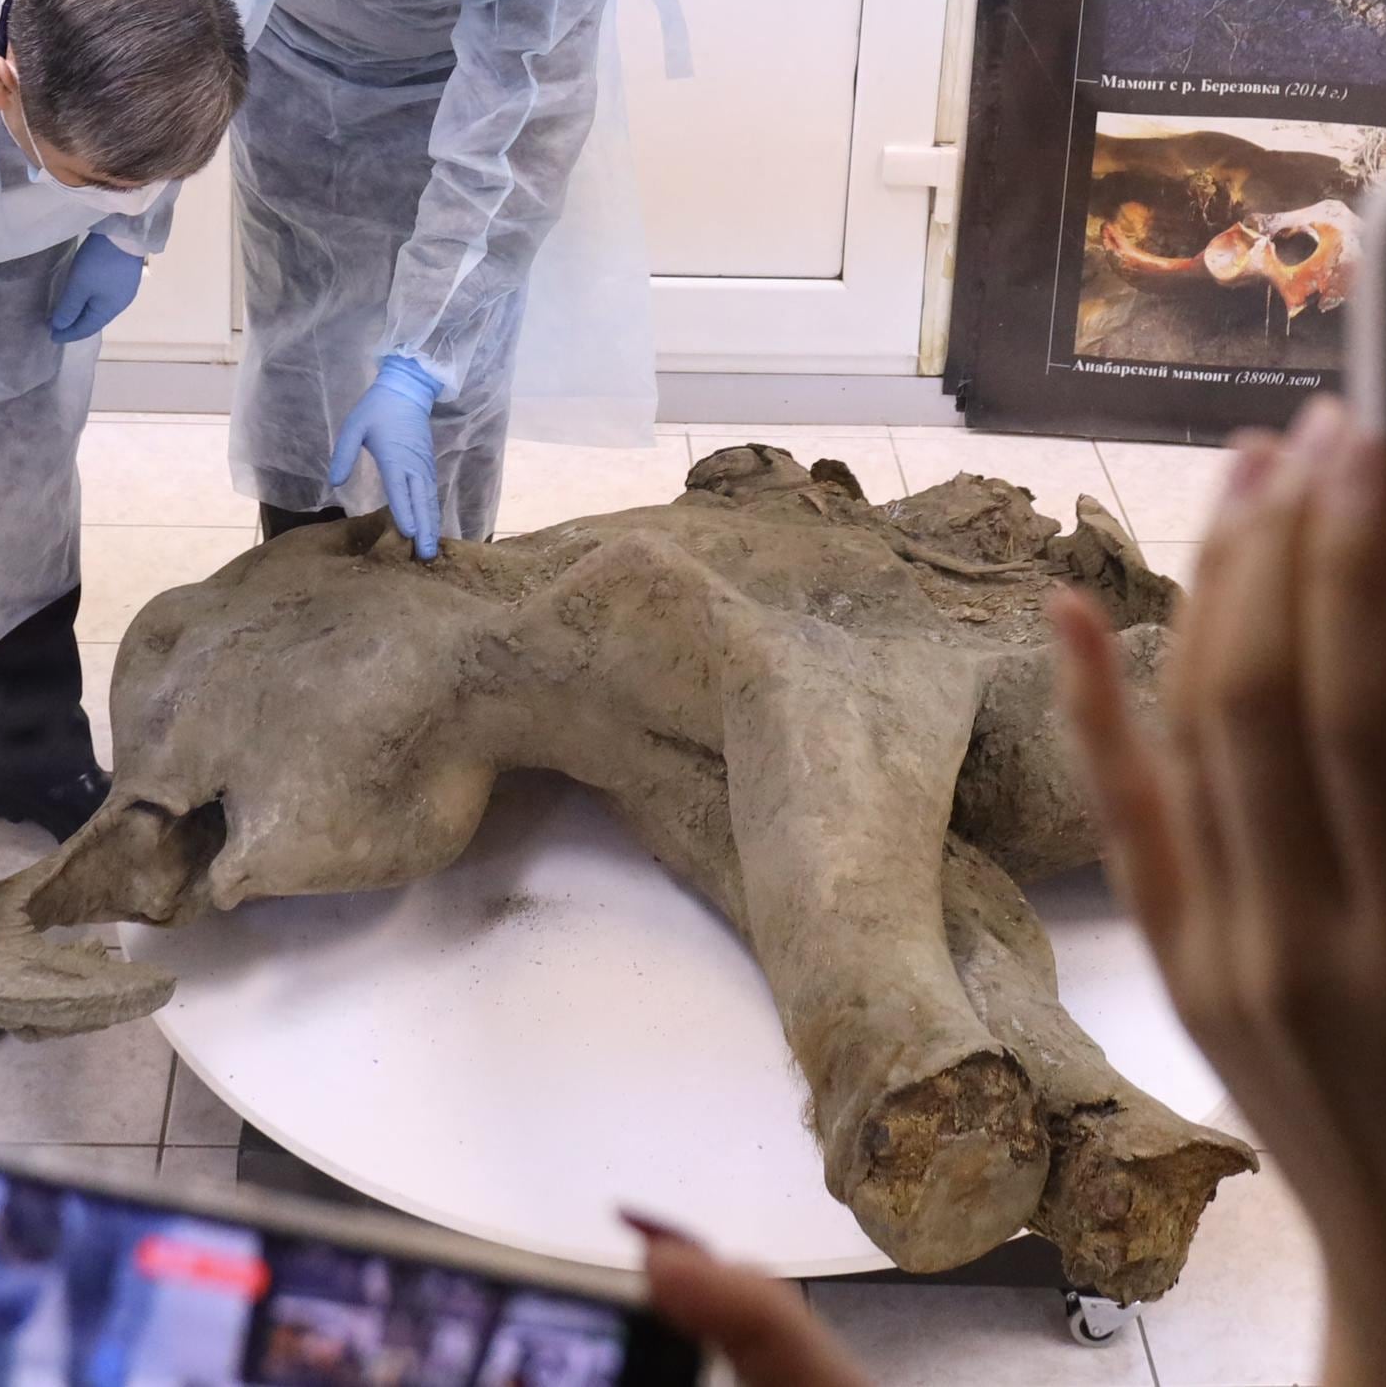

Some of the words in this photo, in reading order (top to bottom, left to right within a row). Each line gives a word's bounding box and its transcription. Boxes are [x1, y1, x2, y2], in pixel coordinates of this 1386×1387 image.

[1101, 74, 1166, 91] Мамонт
[1169, 80, 1178, 91] с
[1181, 80, 1196, 95] р.
[1201, 78, 1280, 95] Березовка
[1285, 82, 1327, 99] (2014
[1329, 87, 1348, 101] г.)
[1072, 359, 1168, 378] Анабарский
[1172, 369, 1232, 383] мамонт
[1234, 371, 1285, 385] (38900
[1286, 373, 1321, 388] лет)
